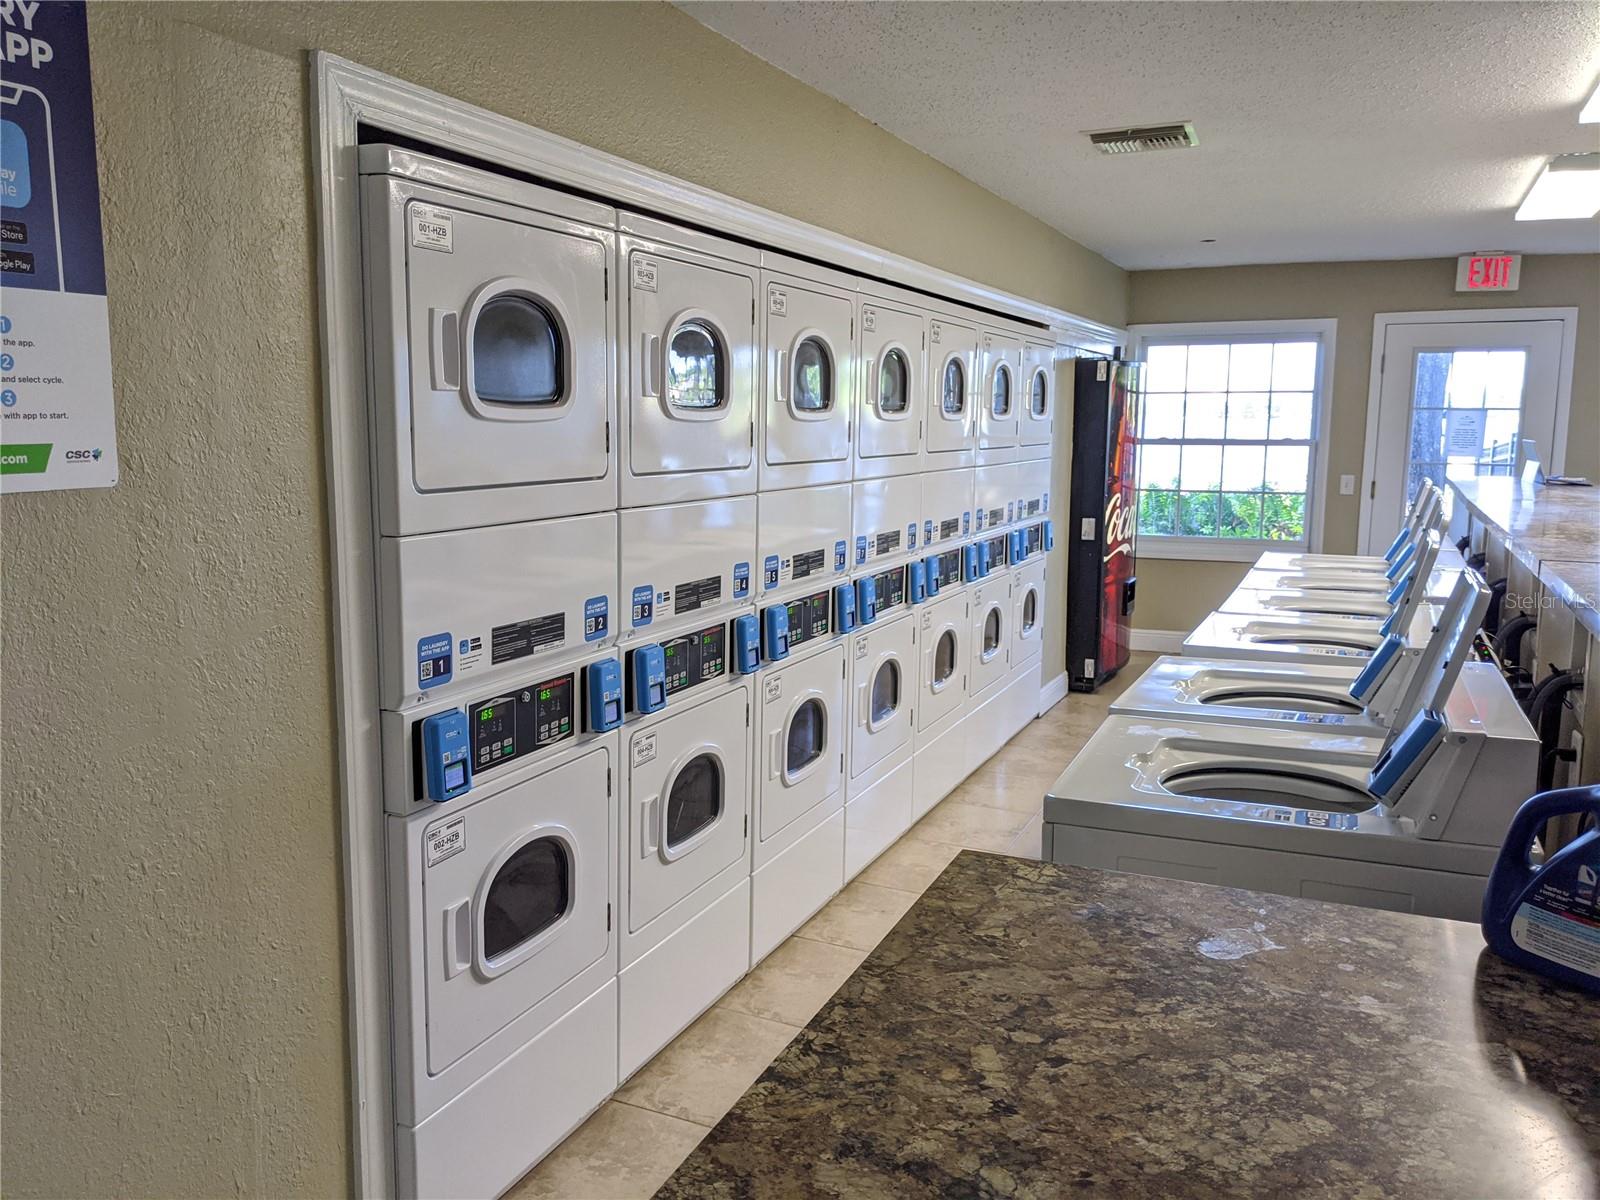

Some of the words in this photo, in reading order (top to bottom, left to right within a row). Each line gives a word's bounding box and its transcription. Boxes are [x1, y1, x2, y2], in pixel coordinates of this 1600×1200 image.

[0, 31, 54, 69] PP
[1, 229, 24, 240] Store
[14, 259, 31, 271] Play
[1469, 256, 1514, 289] EXIT
[3, 338, 16, 346] the
[18, 340, 35, 348] app.
[1, 355, 11, 368] 2
[1, 375, 16, 383] and
[18, 375, 41, 384] select
[42, 376, 64, 385] cycle.
[4, 392, 13, 405] 3
[3, 411, 21, 420] with
[22, 413, 38, 421] app
[39, 412, 48, 420] to
[49, 412, 70, 421] start.
[65, 449, 91, 460] CSC
[643, 604, 649, 617] 3
[598, 617, 604, 629] 2
[438, 659, 444, 673] 1
